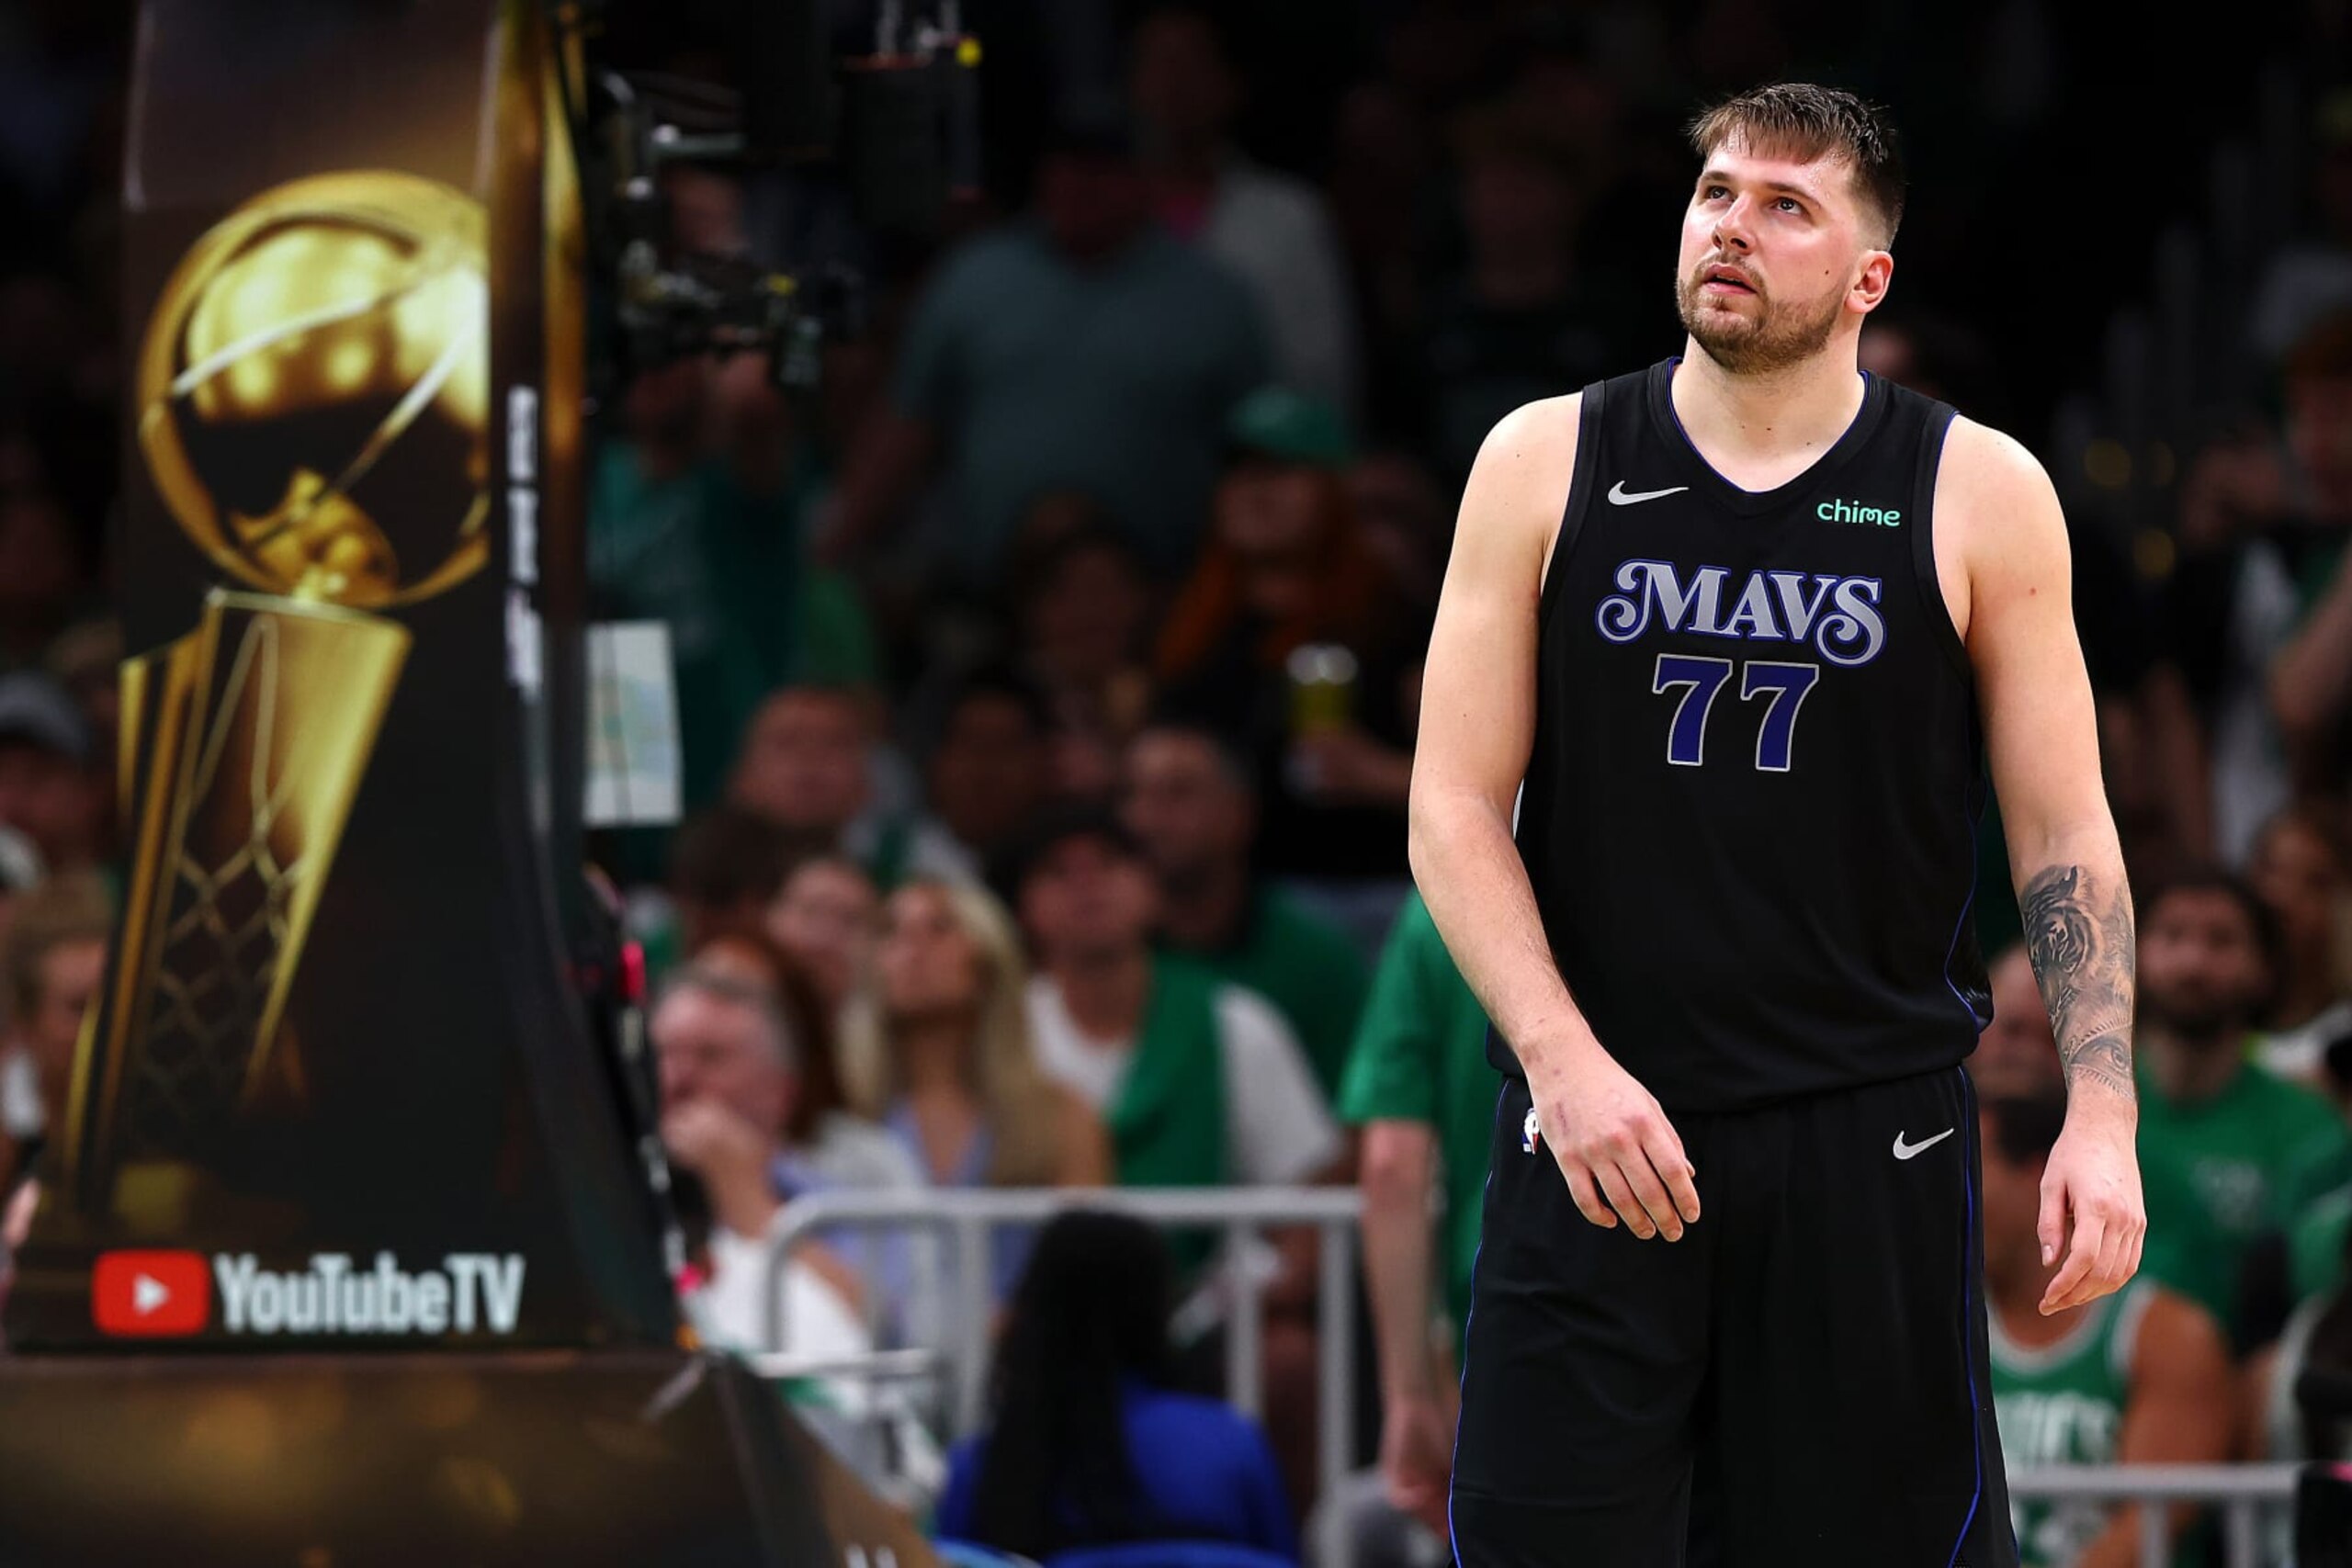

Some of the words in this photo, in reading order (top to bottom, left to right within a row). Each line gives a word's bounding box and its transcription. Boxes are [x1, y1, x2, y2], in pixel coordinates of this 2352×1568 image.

[1816, 499, 1901, 527] chime
[1596, 558, 1885, 667] MAVS
[1653, 653, 1819, 772] 77
